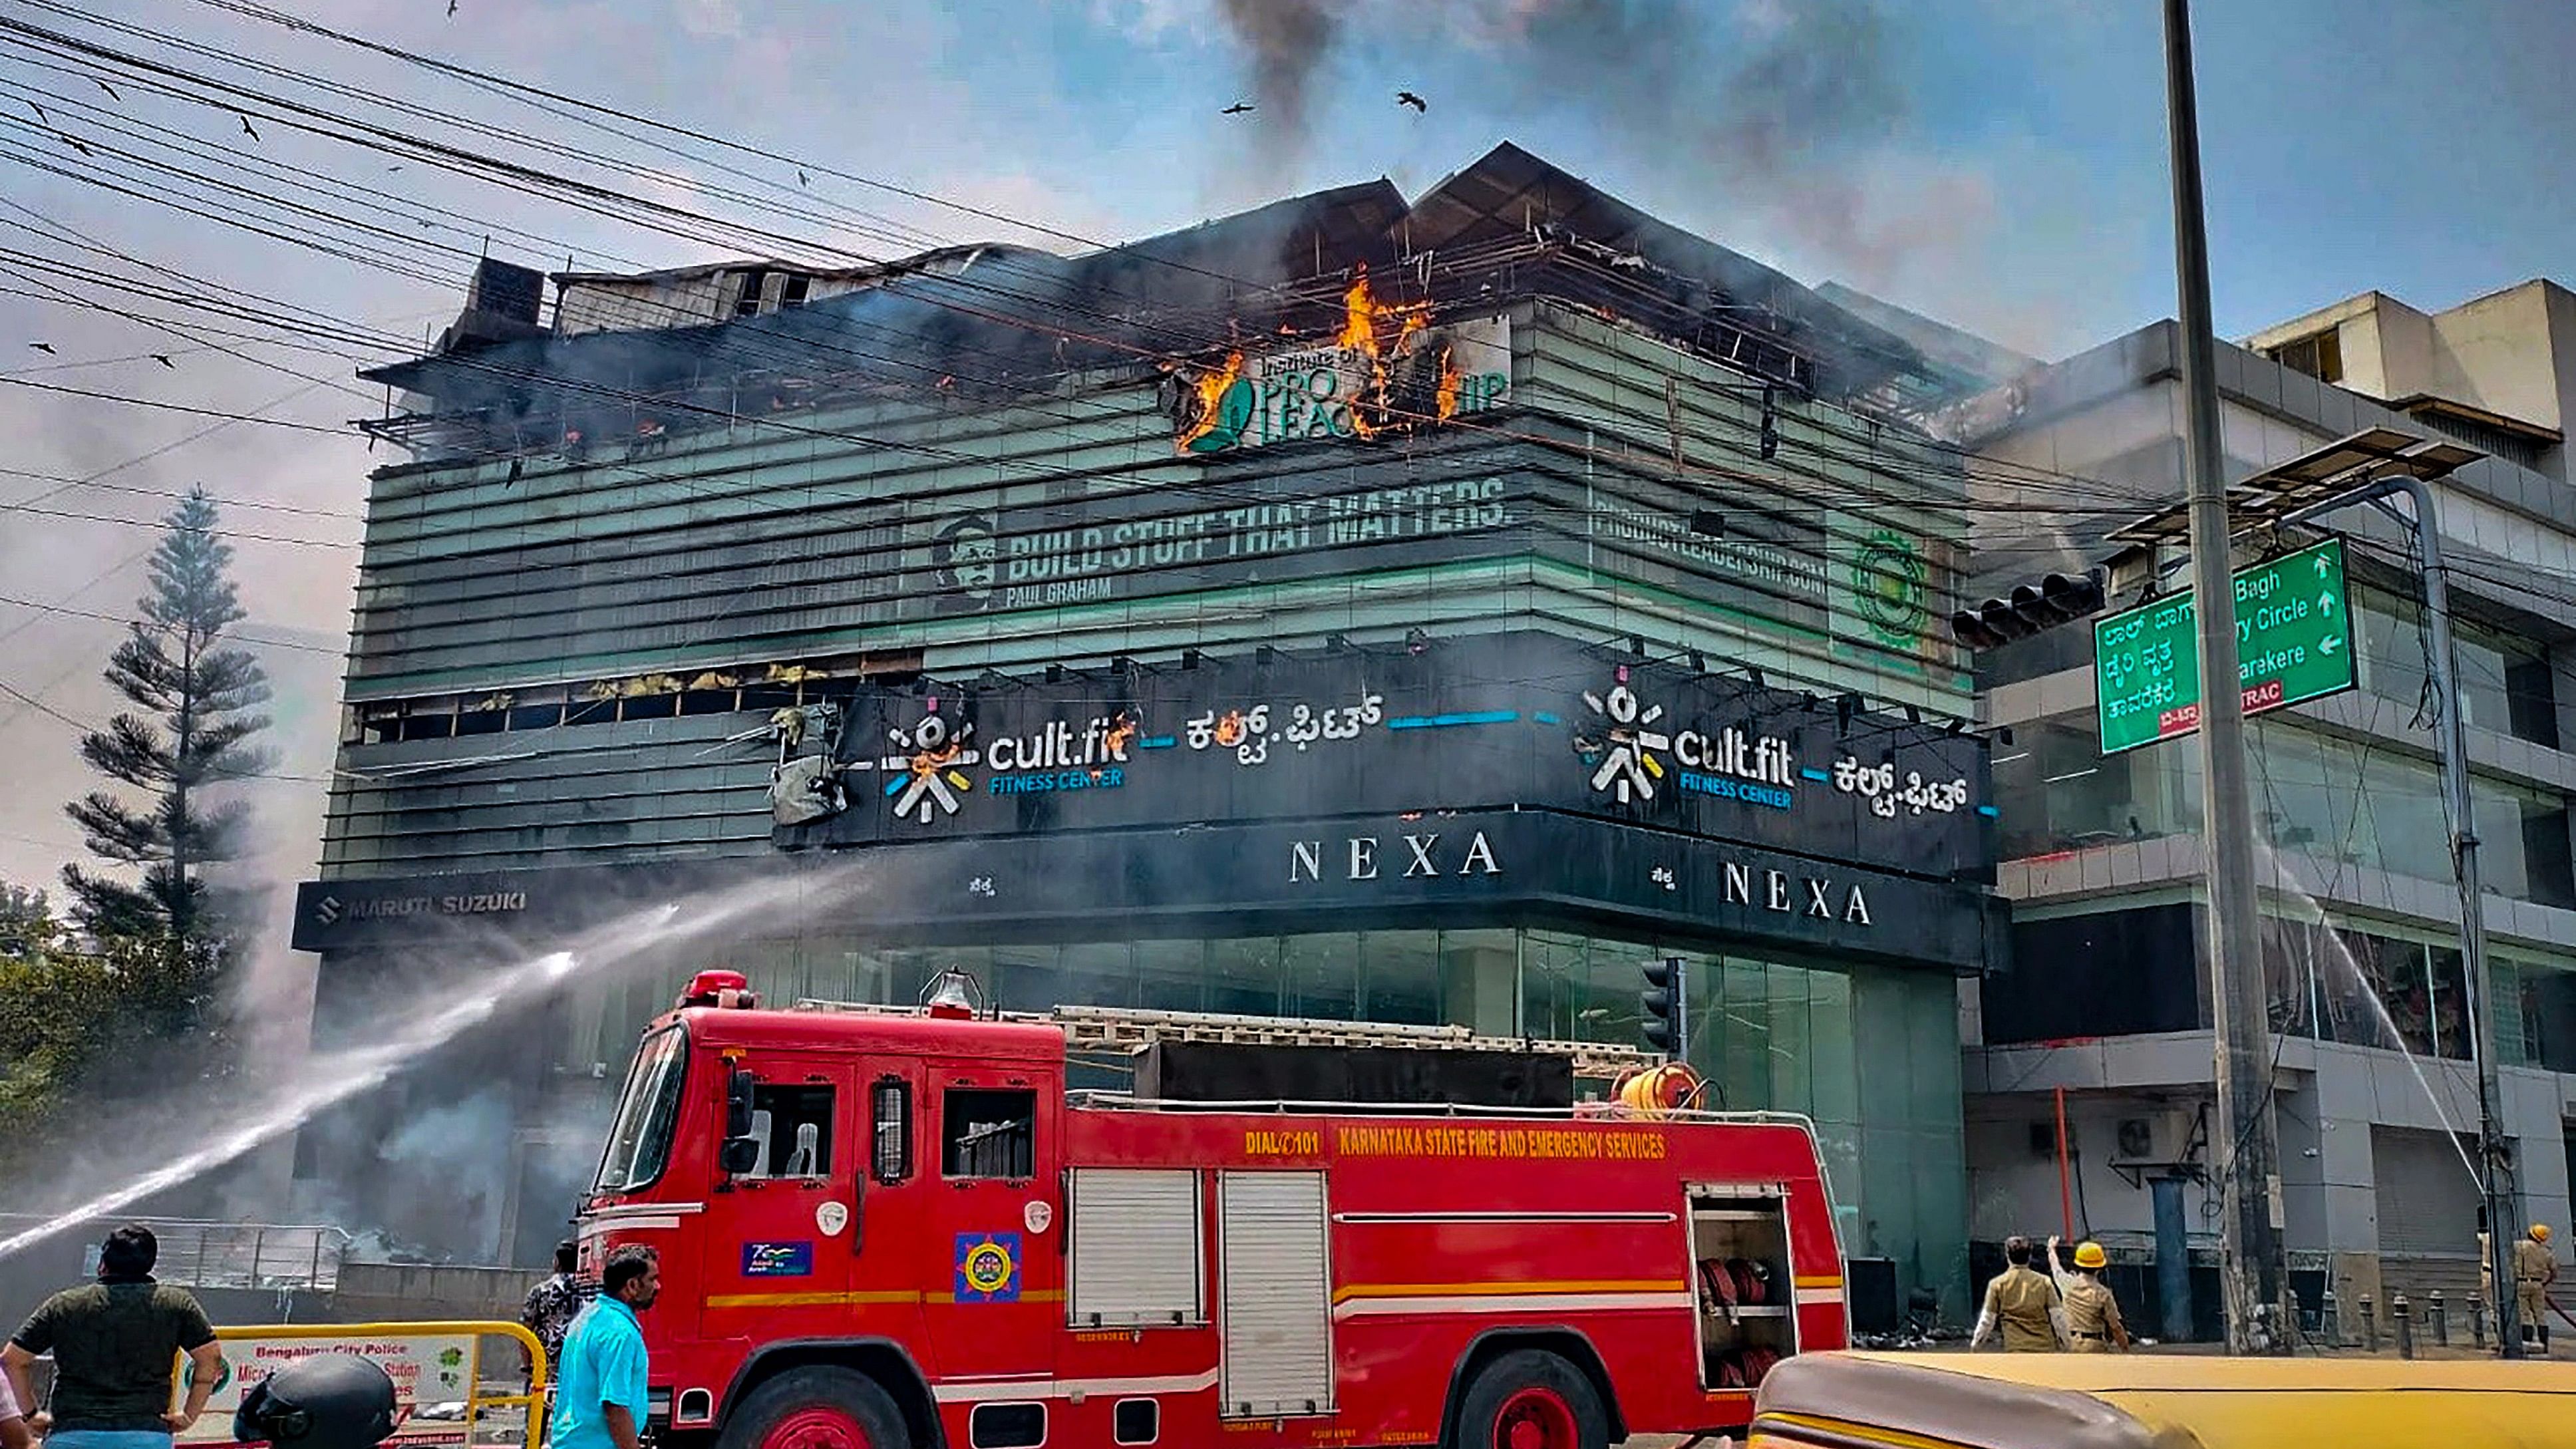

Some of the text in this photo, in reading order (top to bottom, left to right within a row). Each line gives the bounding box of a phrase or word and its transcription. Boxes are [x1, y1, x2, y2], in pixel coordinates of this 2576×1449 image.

[1009, 527, 1102, 581] BUILD
[1112, 513, 1214, 568] STUFF
[1223, 502, 1311, 555] THAT
[1007, 577, 1111, 607] PAUL GRAHAM
[2235, 569, 2281, 601] Bagh
[2257, 597, 2308, 629] Circle
[2239, 645, 2305, 680] arekere
[2241, 683, 2280, 709] TRAC
[988, 715, 1128, 771] cult.fit
[1675, 726, 1794, 787] cult.fit
[990, 772, 1054, 794] FITNESS
[1680, 772, 1793, 810] FITNESS CENTER
[1288, 830, 1502, 884] NEXA
[349, 892, 526, 919] MARUTI SUZUKI
[1724, 863, 1873, 925] NEXA
[1245, 1131, 1318, 1154] DIAL 101
[1339, 1127, 1665, 1160] KARNATAKA STATE FIRE AND EMERGENCY SERVICES
[365, 1343, 408, 1355] Police
[384, 1362, 421, 1379] Station
